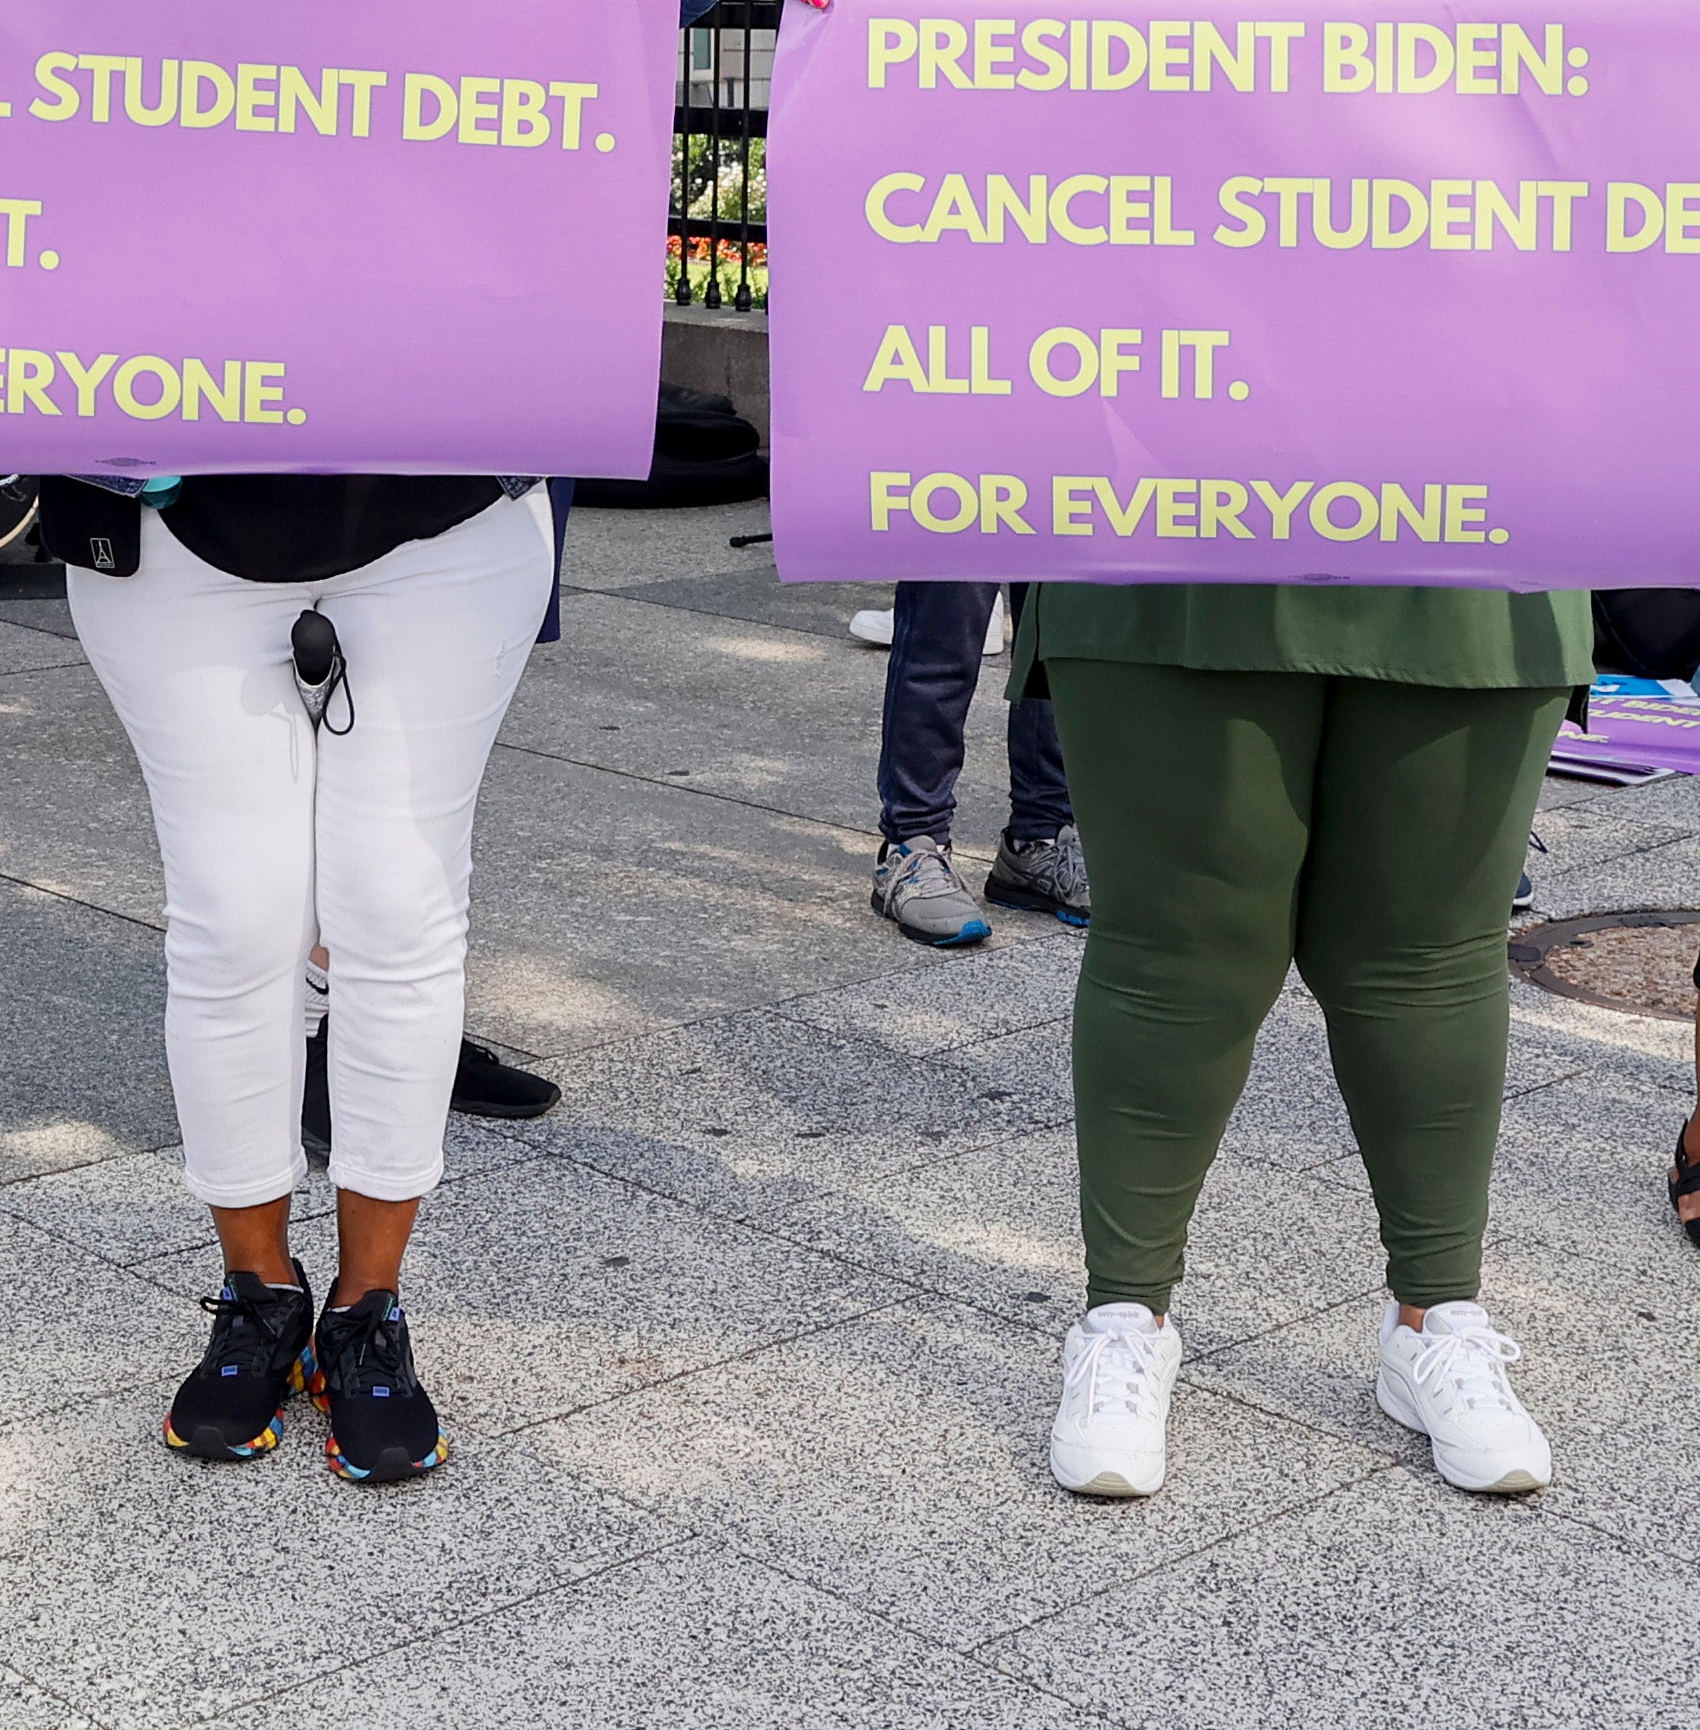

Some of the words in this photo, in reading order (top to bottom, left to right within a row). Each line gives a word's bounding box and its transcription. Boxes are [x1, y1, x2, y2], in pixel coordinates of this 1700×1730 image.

[867, 17, 1307, 93] PRESIDENT
[1323, 21, 1590, 97] BIDEN:
[28, 51, 388, 138] STUDENT
[402, 72, 617, 154] DEBT.
[864, 172, 1196, 246] CANCEL
[1213, 175, 1590, 252] STUDENT
[863, 324, 1013, 396] ALL
[1028, 326, 1143, 398] OF
[1161, 329, 1251, 402] IT.
[869, 470, 1035, 536] FOR
[1051, 475, 1511, 545] EVERYONE.
